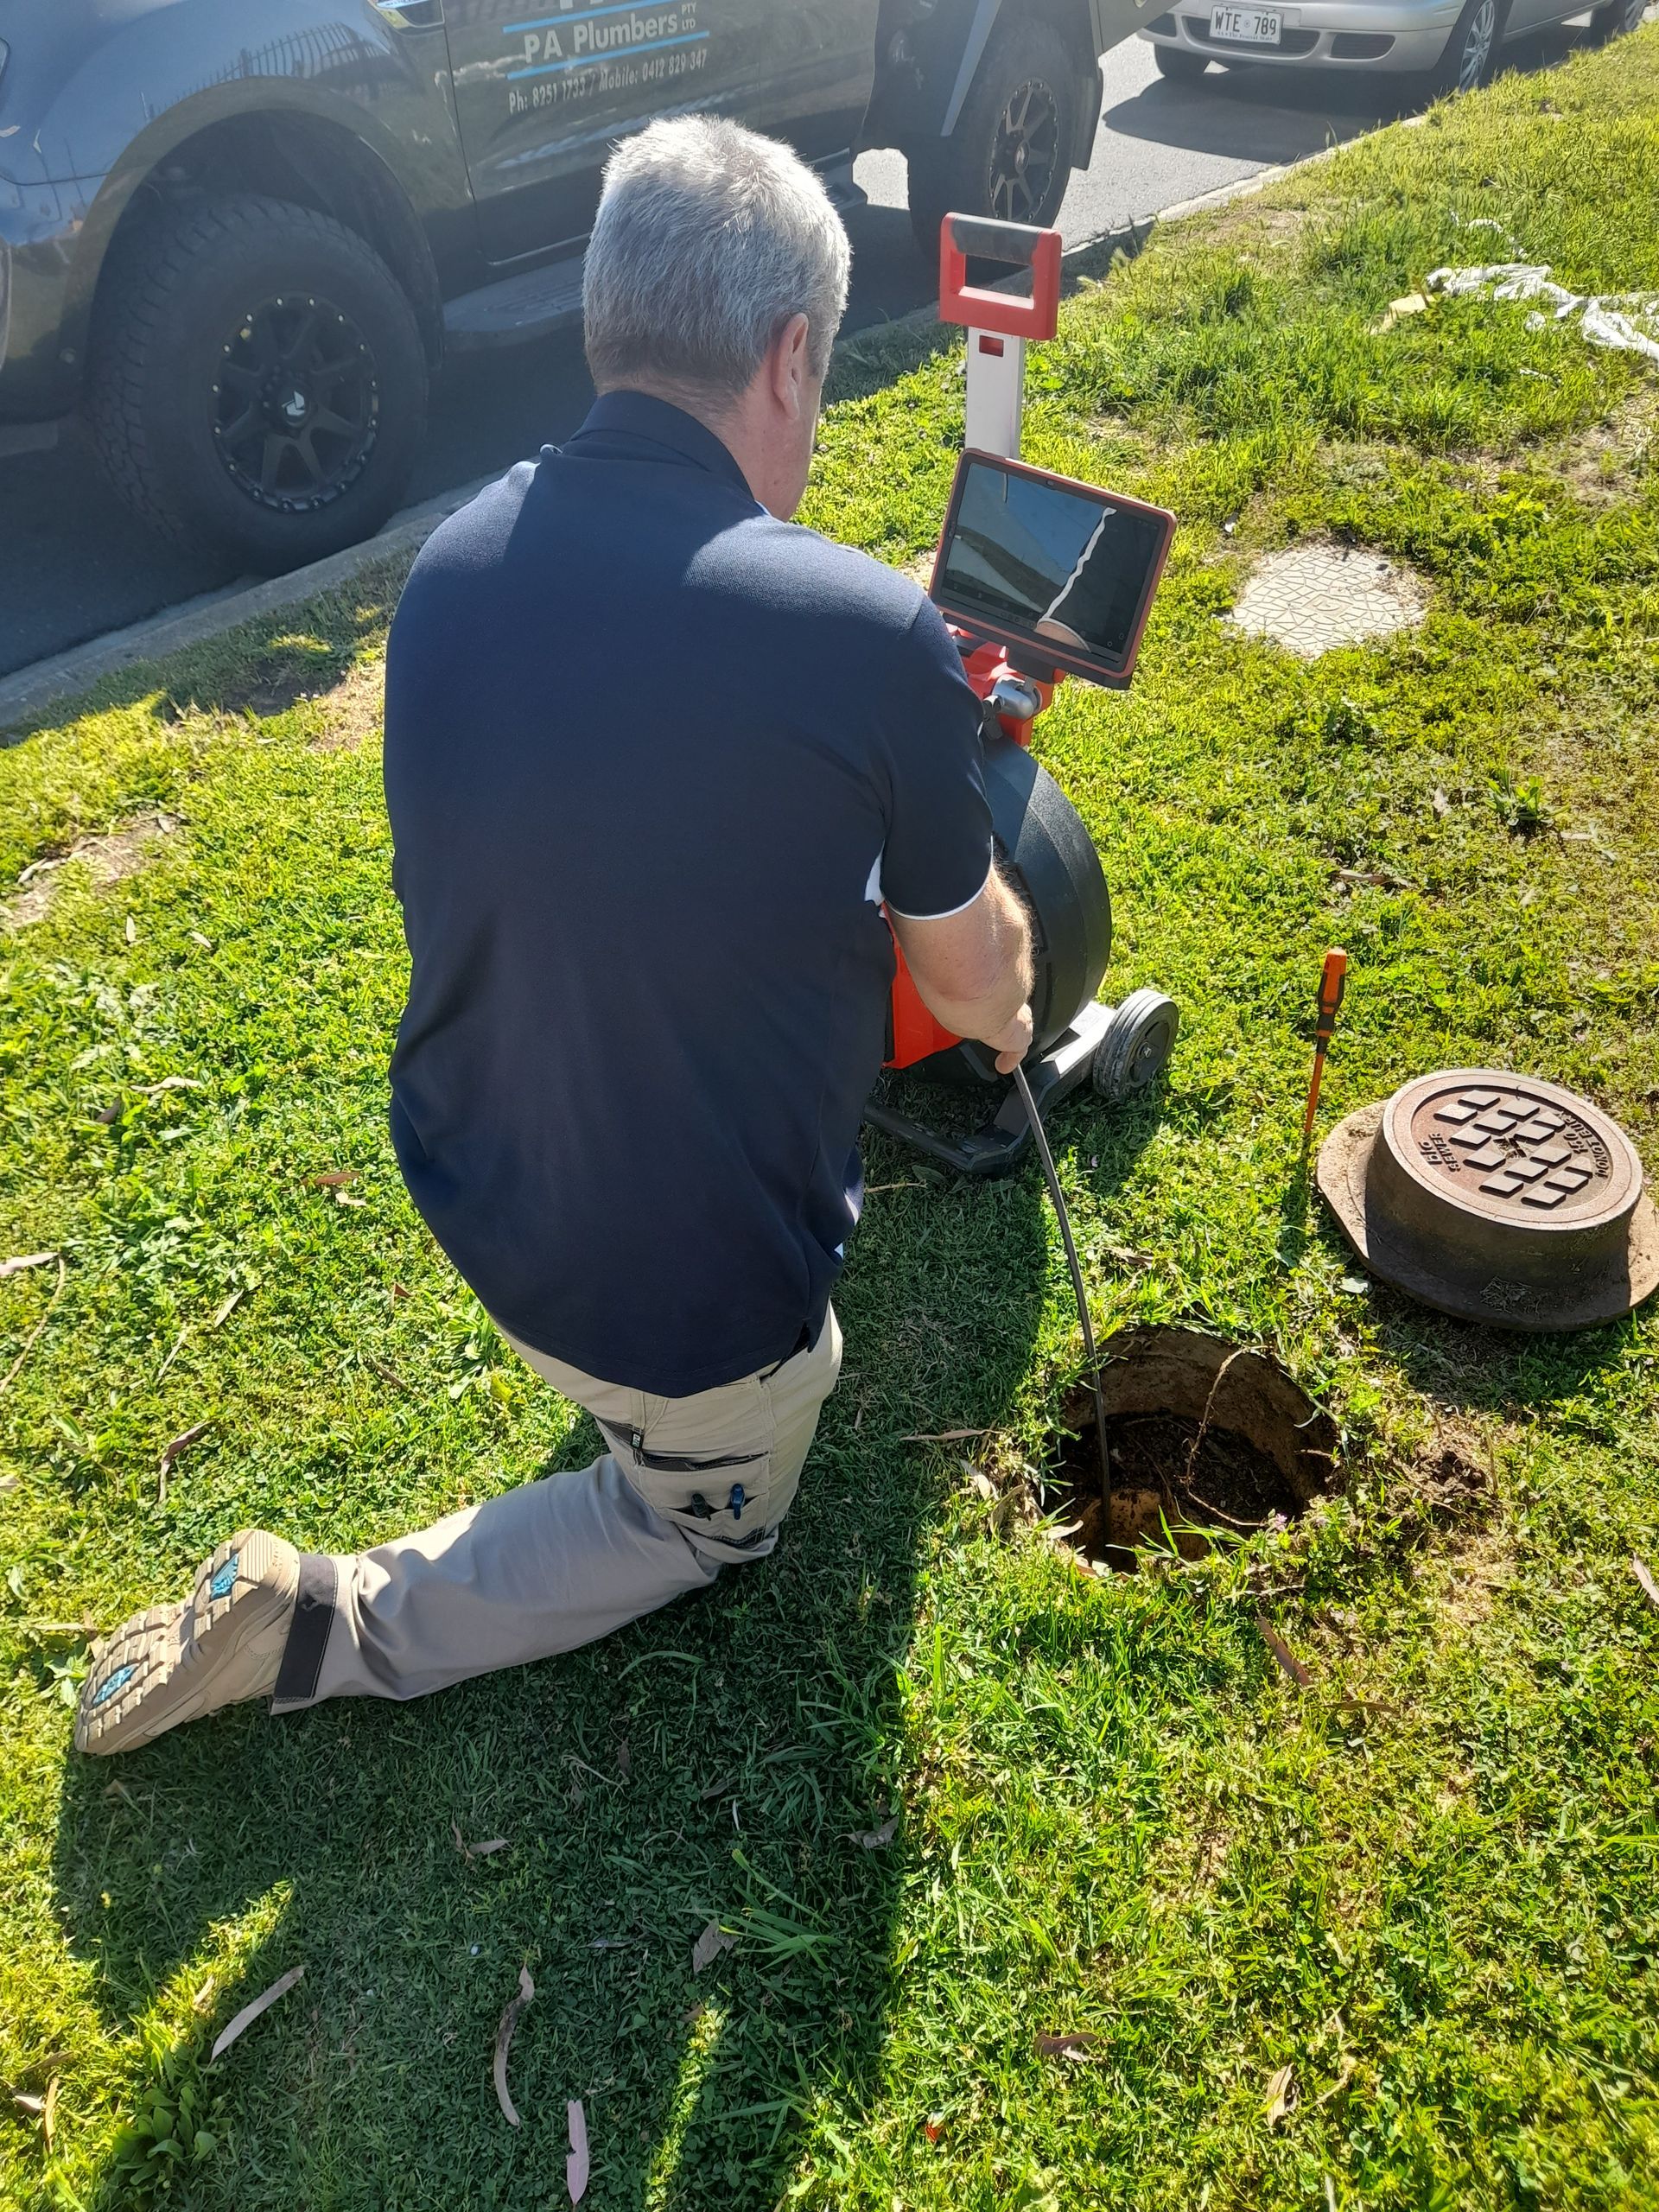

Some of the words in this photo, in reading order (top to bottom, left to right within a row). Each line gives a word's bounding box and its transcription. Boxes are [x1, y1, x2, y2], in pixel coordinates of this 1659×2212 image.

[682, 3, 696, 15] PTY
[682, 18, 696, 30] LTD
[1216, 11, 1242, 32] WTE
[1254, 16, 1277, 35] 789
[524, 30, 563, 63] PA
[573, 13, 677, 53] Plumbers
[509, 91, 528, 113] Ph:
[532, 82, 557, 108] 8251
[563, 76, 586, 101] 1733
[599, 65, 638, 92] Mobile:
[642, 59, 665, 81] 0412
[669, 54, 686, 75] 829
[690, 49, 707, 70] 347
[1427, 1133, 1461, 1172] SEWER
